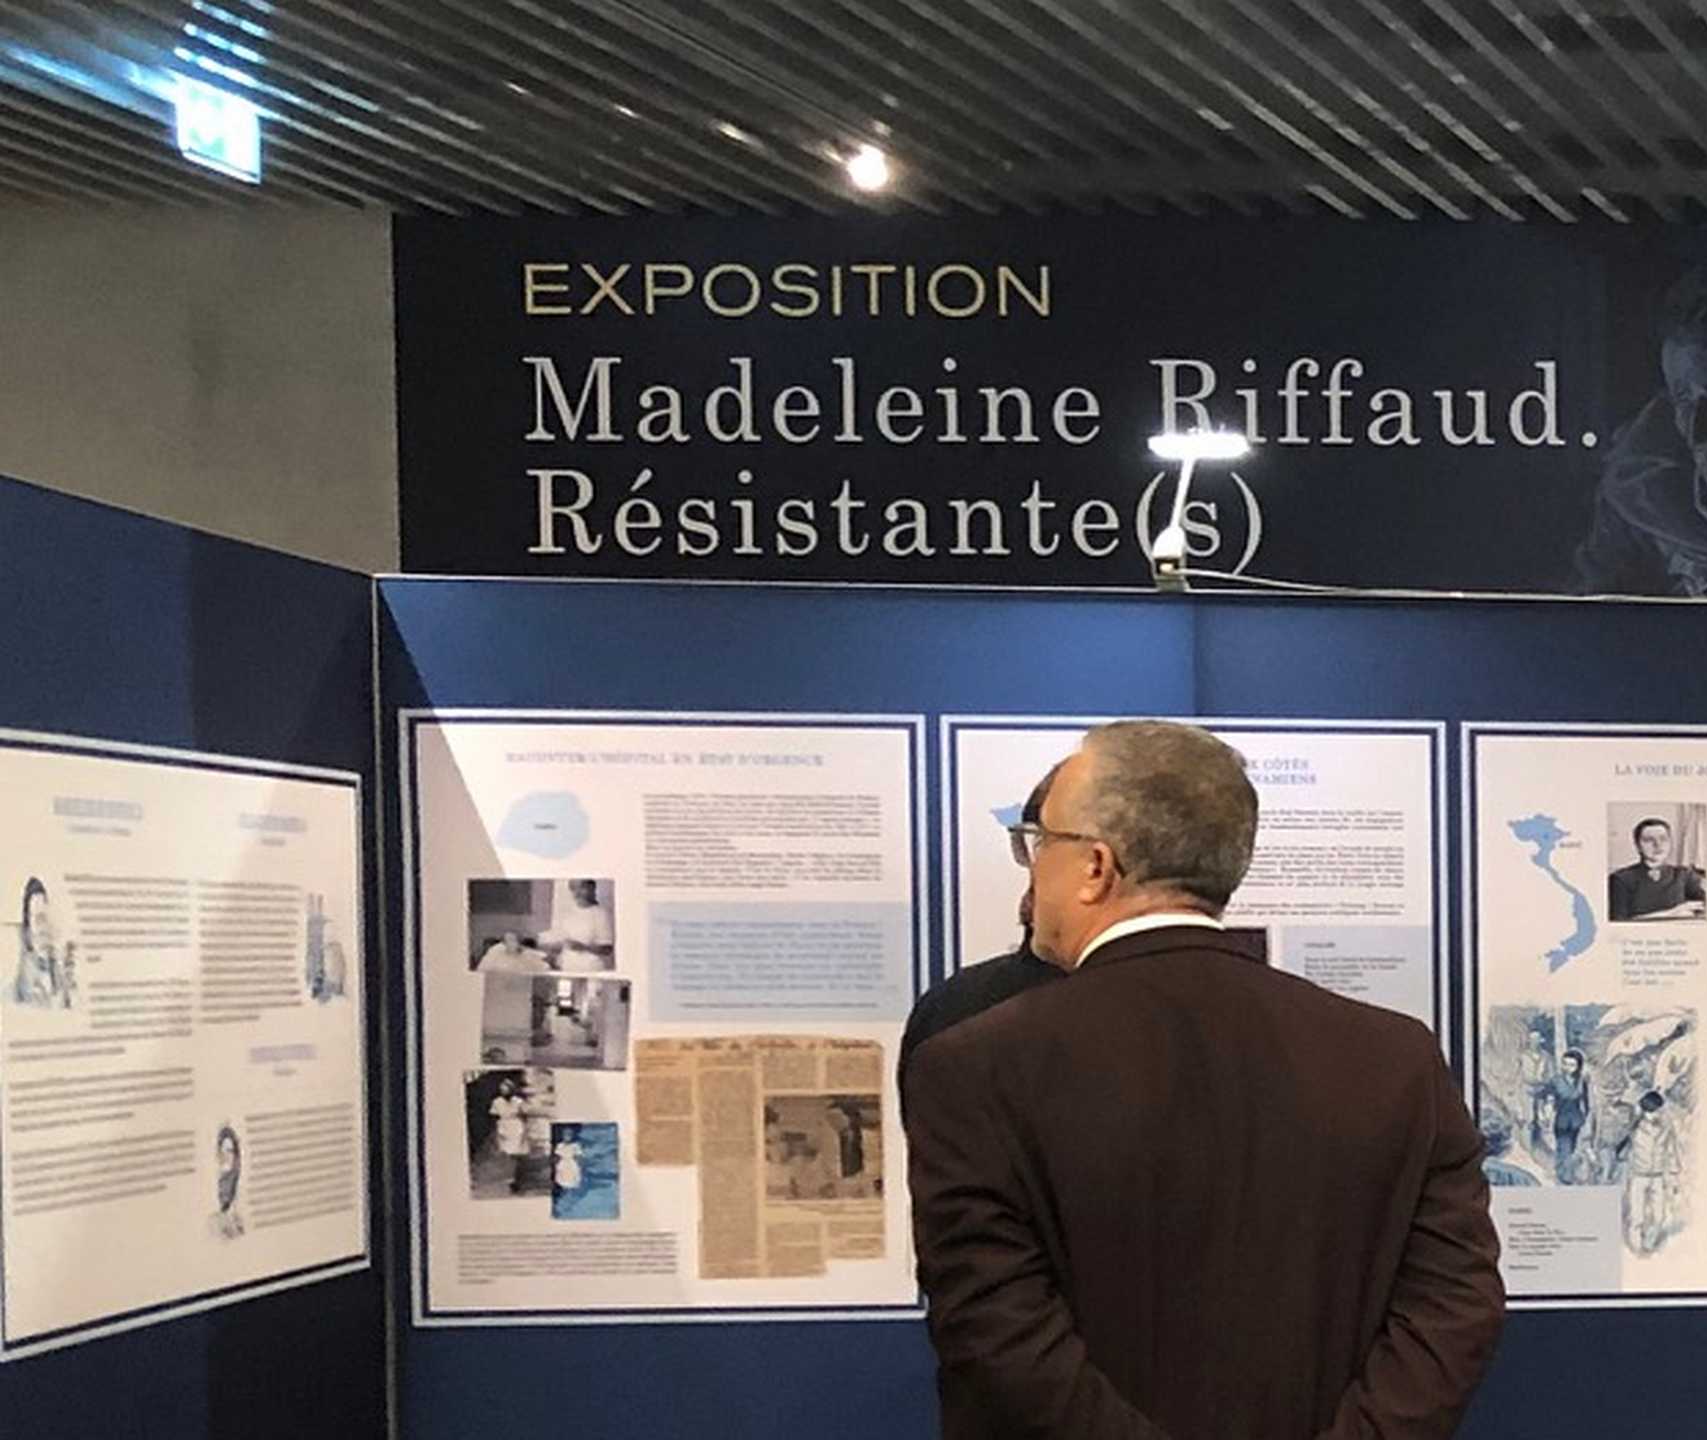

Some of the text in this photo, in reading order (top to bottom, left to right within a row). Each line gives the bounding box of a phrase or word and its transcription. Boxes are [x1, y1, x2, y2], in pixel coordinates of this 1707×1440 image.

[526, 263, 1051, 318] EXPOSITION
[524, 356, 1598, 447] Madeleine Riffaud.
[526, 468, 1263, 577] Résistante(s)
